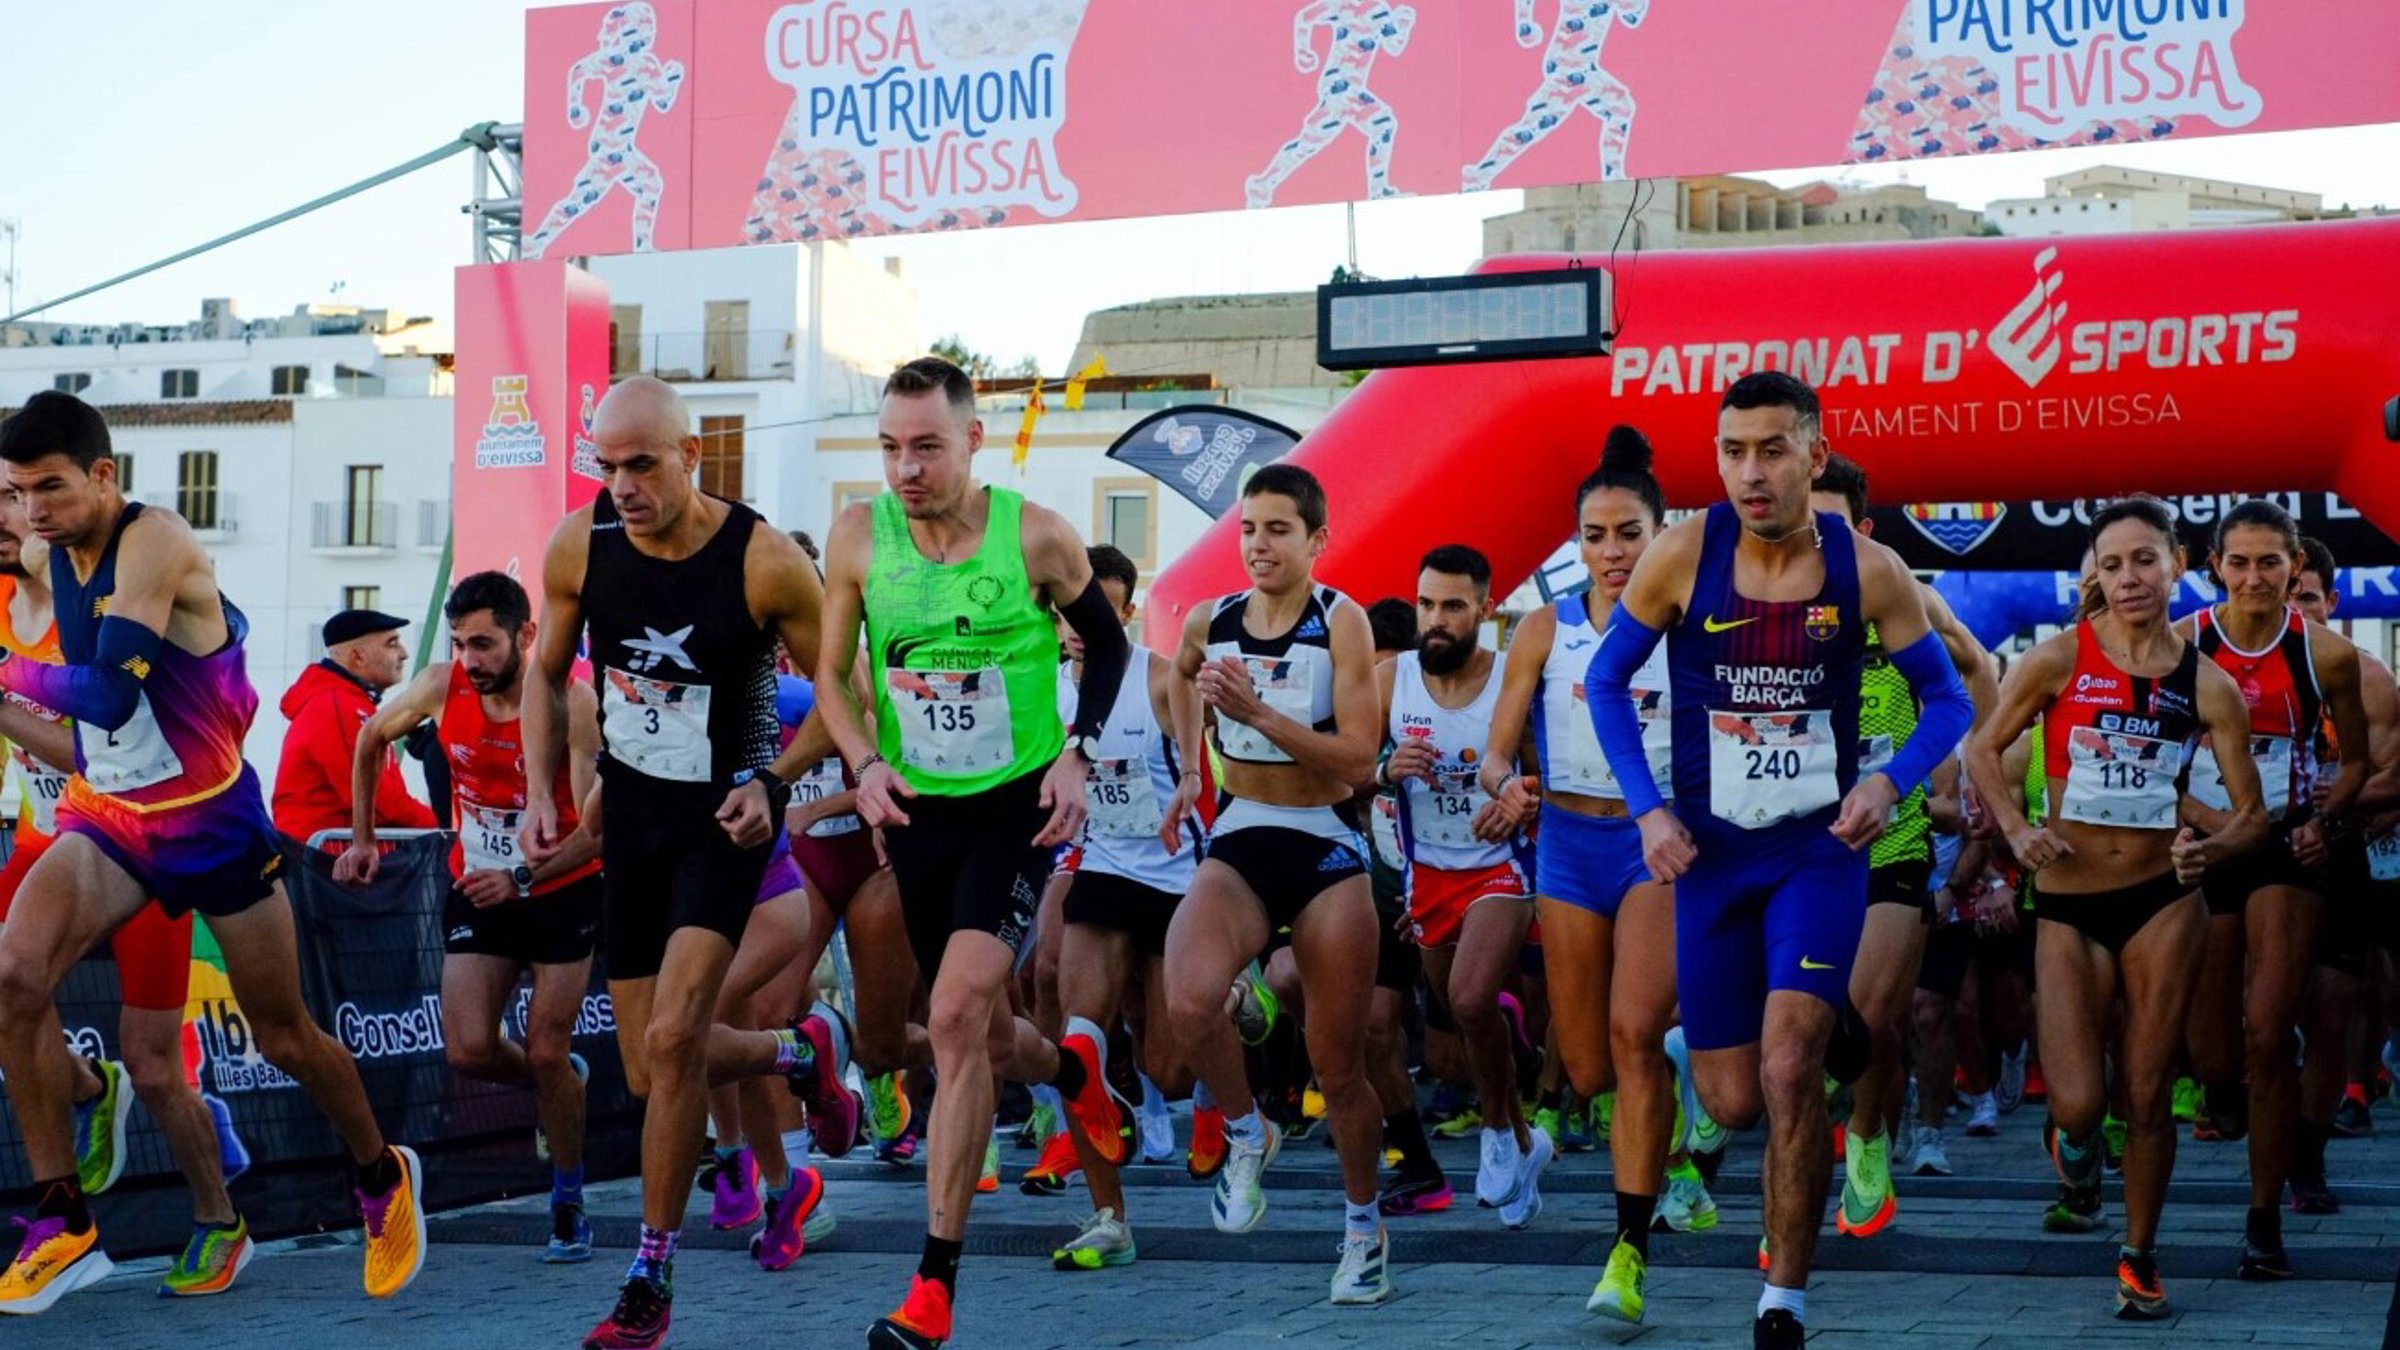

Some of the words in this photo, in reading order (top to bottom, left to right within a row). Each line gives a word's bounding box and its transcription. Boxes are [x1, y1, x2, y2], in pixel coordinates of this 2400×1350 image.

[778, 1, 936, 76] CURSA
[2014, 32, 2246, 125] EIVISSA
[810, 53, 1054, 147] PATRIMONI
[877, 130, 1064, 213] EIVISSA
[1610, 333, 1904, 397] PATRONAT
[1819, 401, 1983, 438] TAMENT
[1998, 394, 2182, 434] D'EIVISSA
[1715, 664, 1824, 685] FUNDACIÓ
[1731, 685, 1807, 709] BARÇA
[644, 708, 660, 735] 3
[923, 704, 975, 731] 135
[2123, 717, 2161, 737] BM
[1745, 749, 1801, 780] 240
[2100, 763, 2147, 790] 118
[793, 784, 823, 803] 170
[1092, 784, 1131, 805] 185
[1434, 796, 1473, 816] 134
[481, 831, 513, 857] 145
[1318, 858, 1359, 872] adidas
[215, 1063, 253, 1089] Illes
